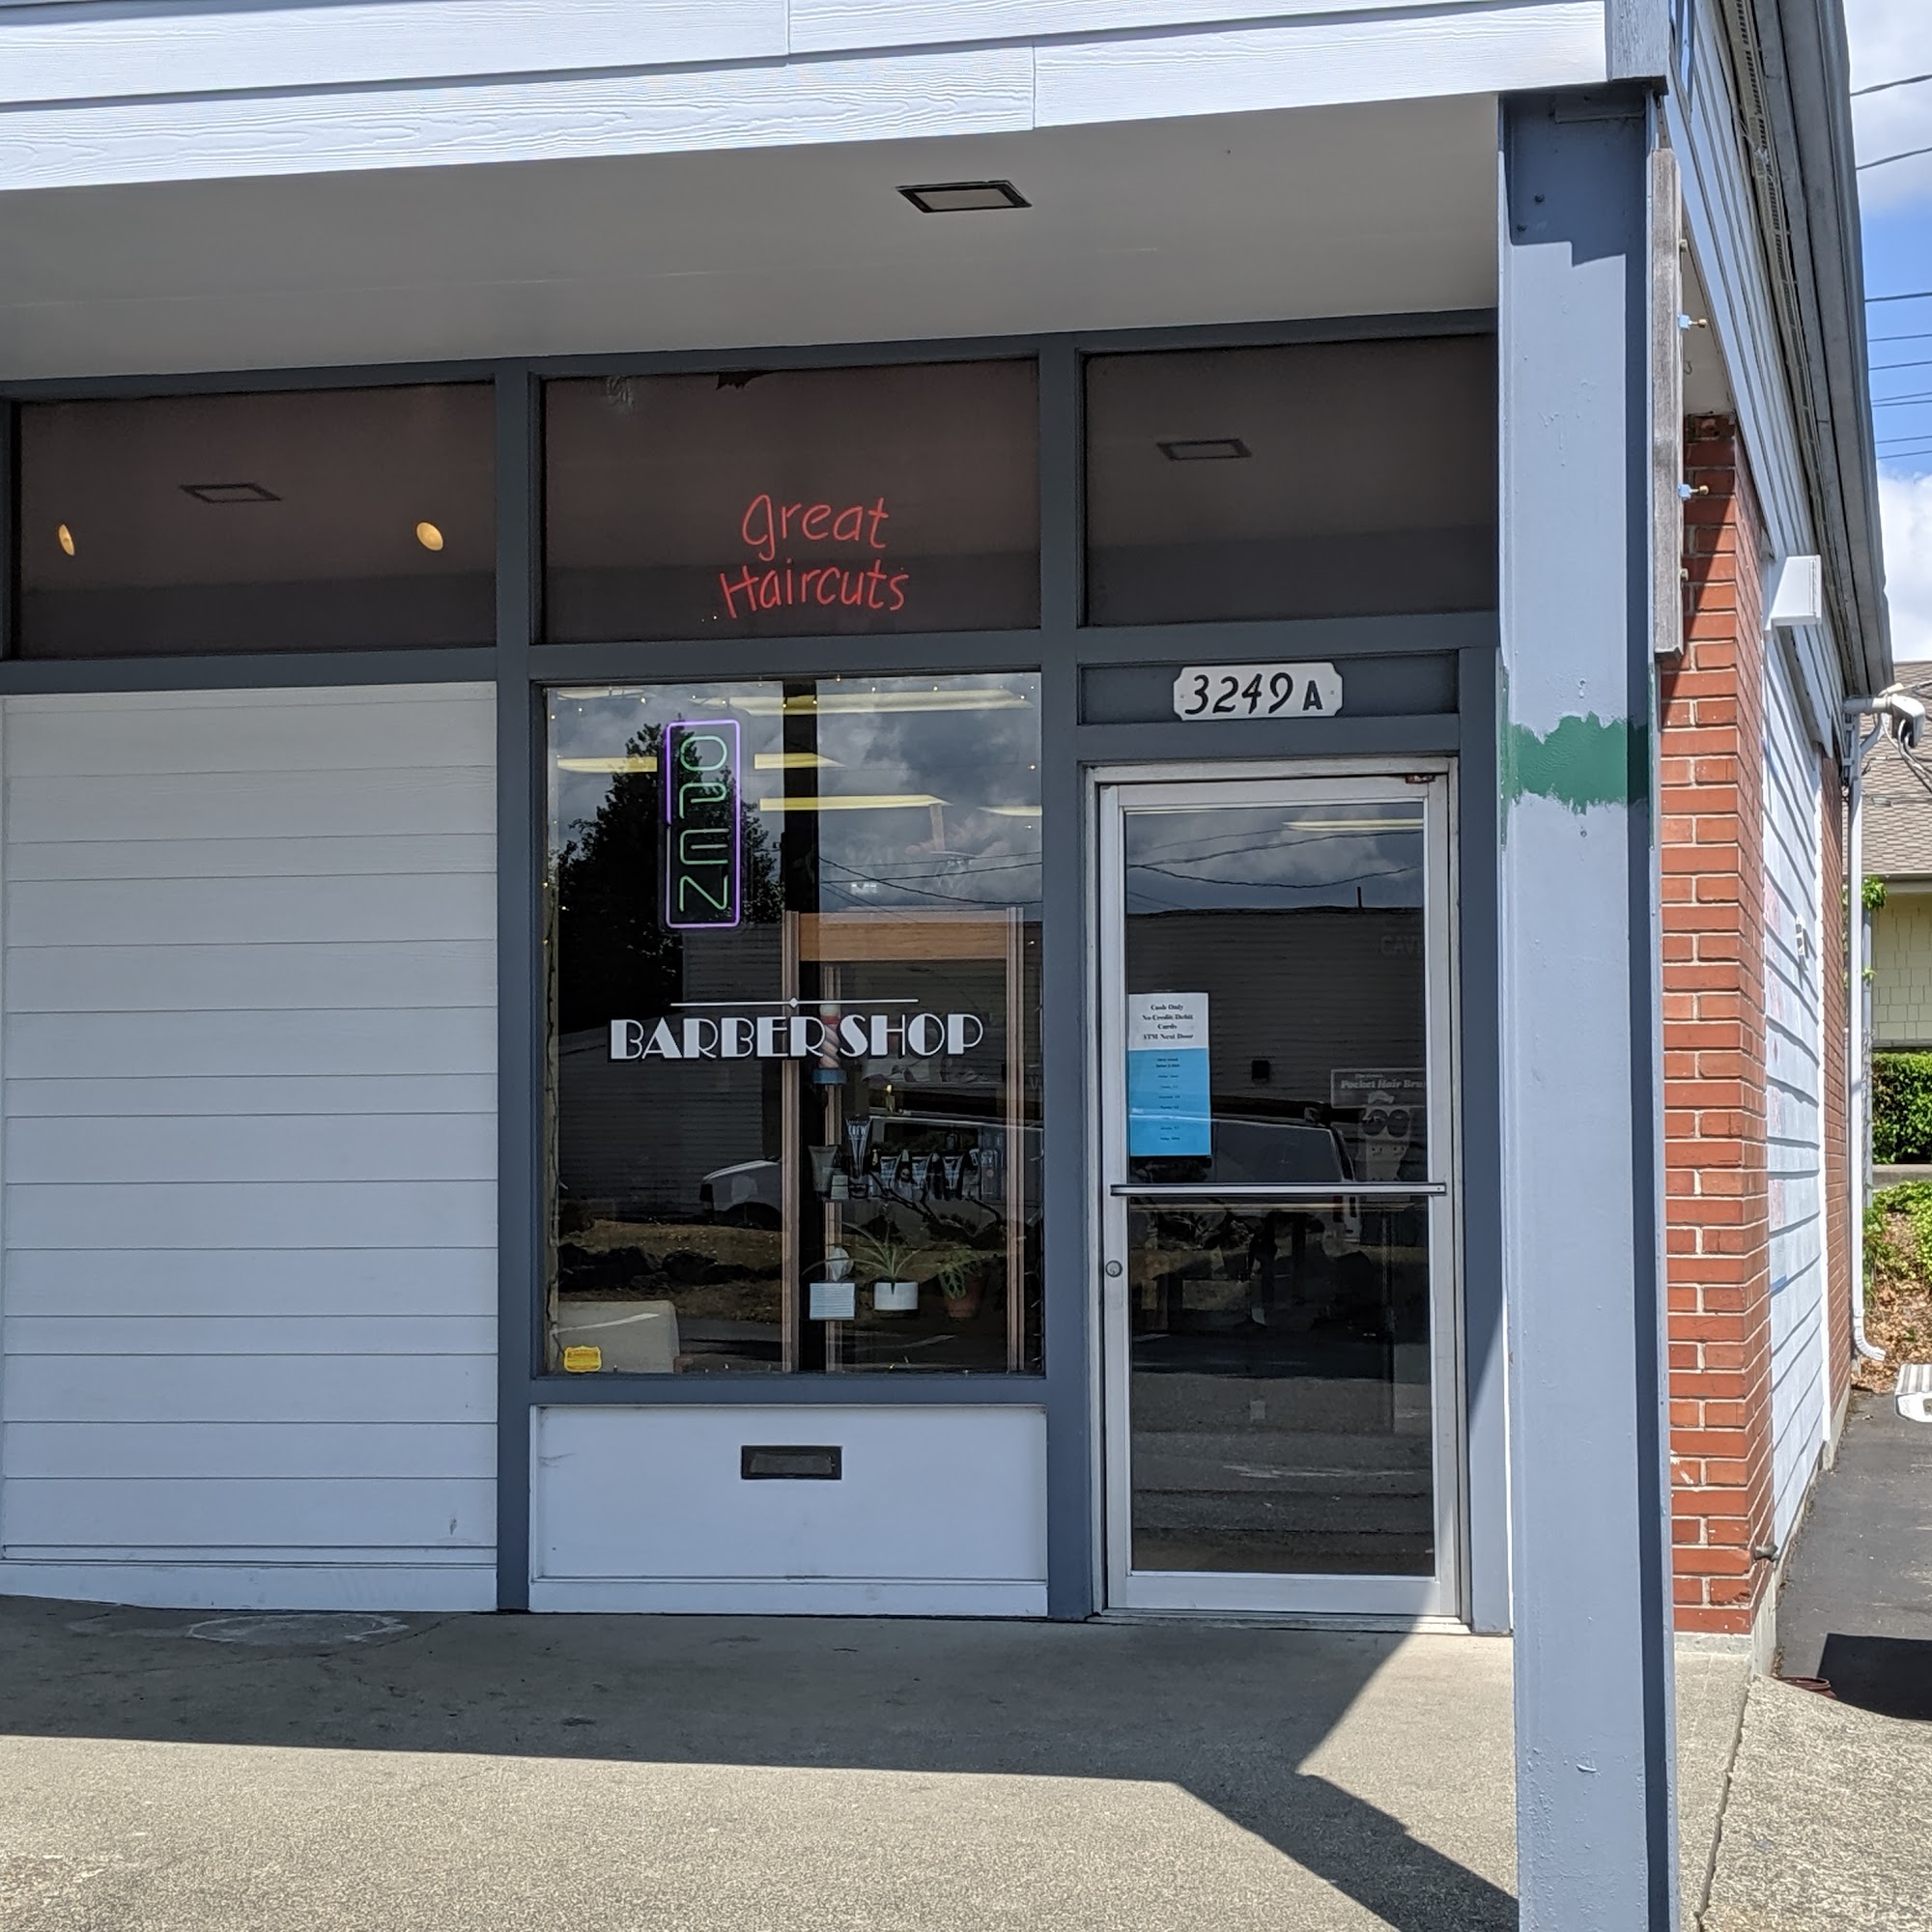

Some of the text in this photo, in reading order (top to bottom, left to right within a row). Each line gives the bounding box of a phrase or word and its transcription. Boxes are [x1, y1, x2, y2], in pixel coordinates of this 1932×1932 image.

[720, 557, 909, 618] Haircuts
[680, 735, 730, 912] OPEN
[611, 1013, 983, 1060] BARBER SHOP
[1341, 1078, 1425, 1089] Pocket Hair Bru
